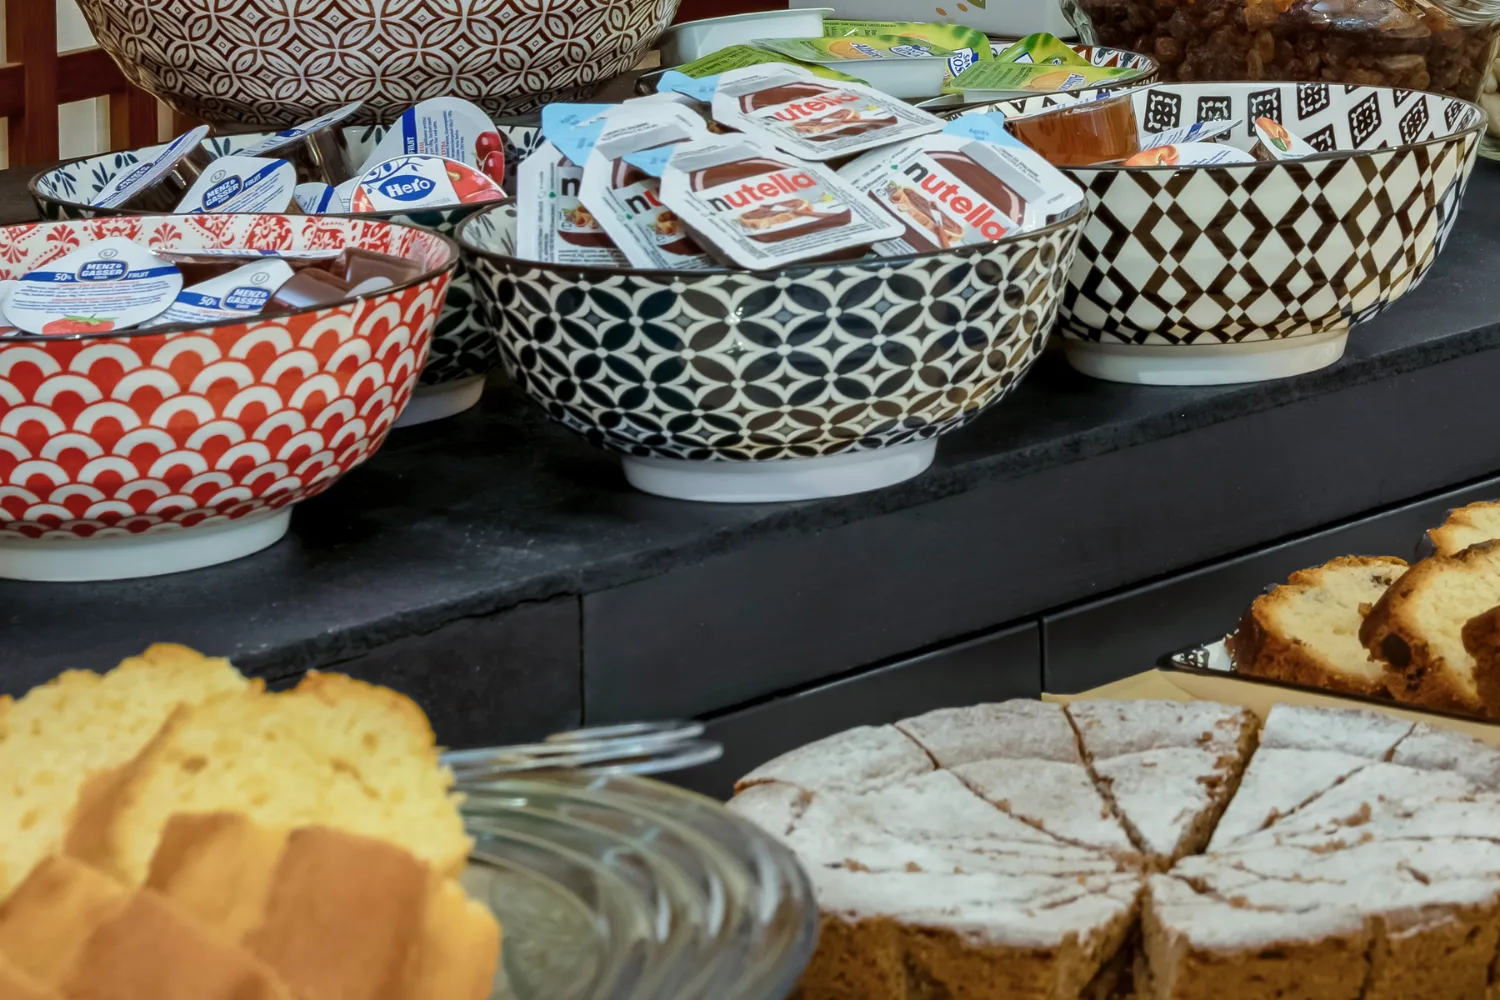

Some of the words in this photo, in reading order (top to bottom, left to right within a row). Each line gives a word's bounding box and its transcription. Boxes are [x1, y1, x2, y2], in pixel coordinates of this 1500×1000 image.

[762, 93, 861, 123] nutella
[385, 177, 431, 198] Hero
[706, 171, 817, 213] nutella
[902, 161, 1009, 242] nutella
[80, 269, 123, 277] GASSER
